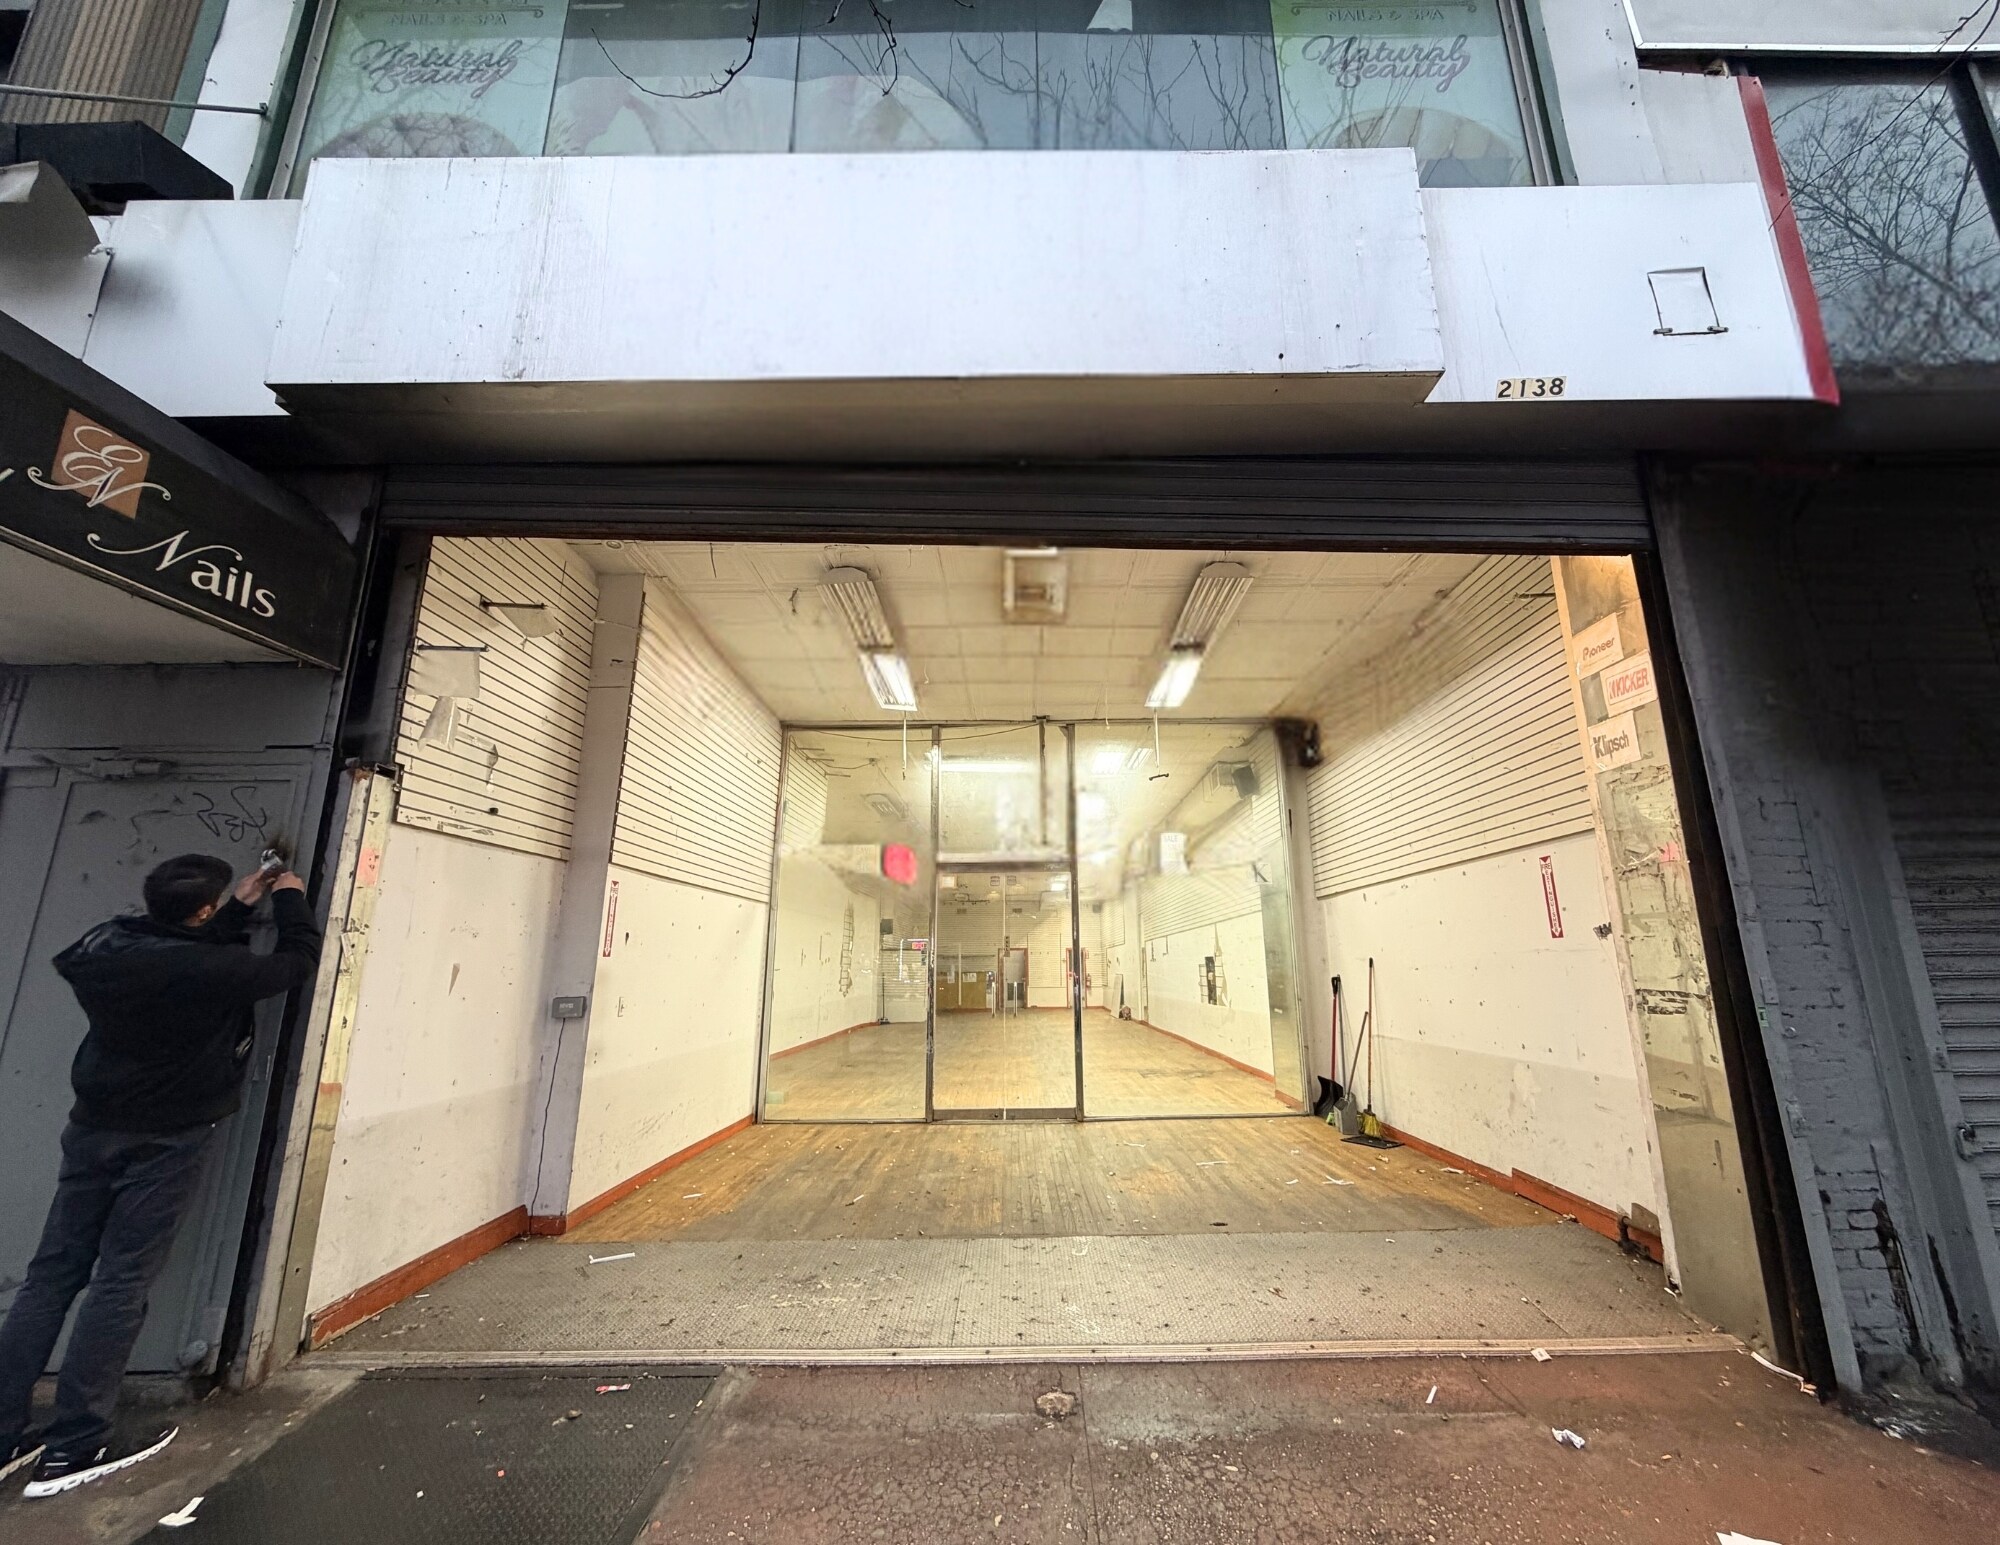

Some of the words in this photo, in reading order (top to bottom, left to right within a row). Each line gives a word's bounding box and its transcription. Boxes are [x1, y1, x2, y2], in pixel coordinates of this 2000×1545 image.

[391, 13, 446, 26] NAILS
[477, 13, 508, 26] SPA
[1329, 9, 1383, 22] NAILS
[1412, 9, 1445, 21] SPA
[351, 39, 523, 71] Natural
[1302, 35, 1468, 66] Natural
[368, 58, 518, 98] Beauty
[1327, 55, 1471, 93] Beauty
[1498, 377, 1564, 399] 2138
[86, 530, 277, 618] Nails
[1582, 637, 1616, 661] Pioneer
[1593, 730, 1630, 763] Klipsch
